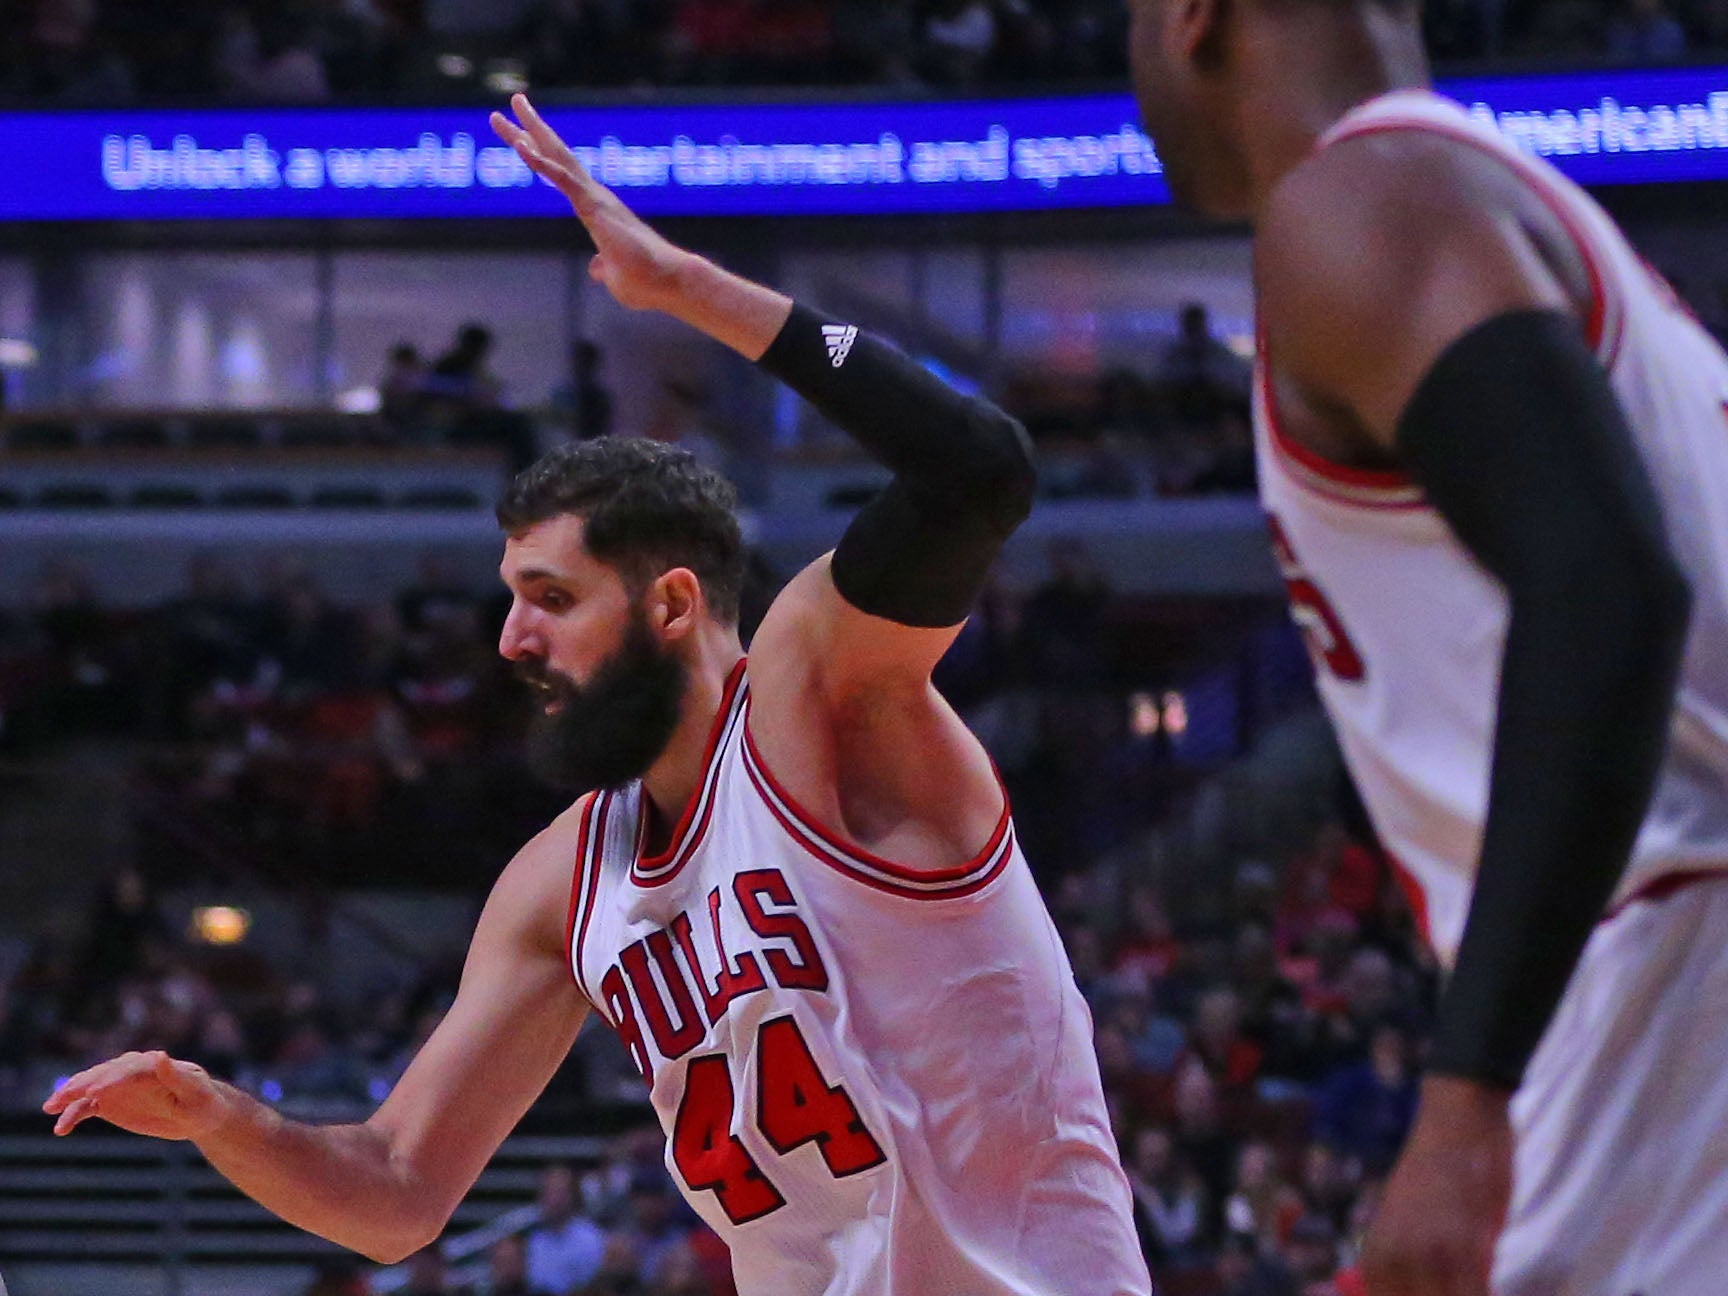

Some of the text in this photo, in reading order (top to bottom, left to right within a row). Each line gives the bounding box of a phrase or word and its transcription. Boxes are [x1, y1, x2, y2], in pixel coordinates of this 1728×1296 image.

[102, 133, 281, 190] Unlock
[284, 147, 324, 189] a
[535, 134, 905, 188] ntertainment
[909, 124, 1009, 184] and
[601, 868, 829, 1092] BULLS
[672, 1014, 888, 1226] 44
